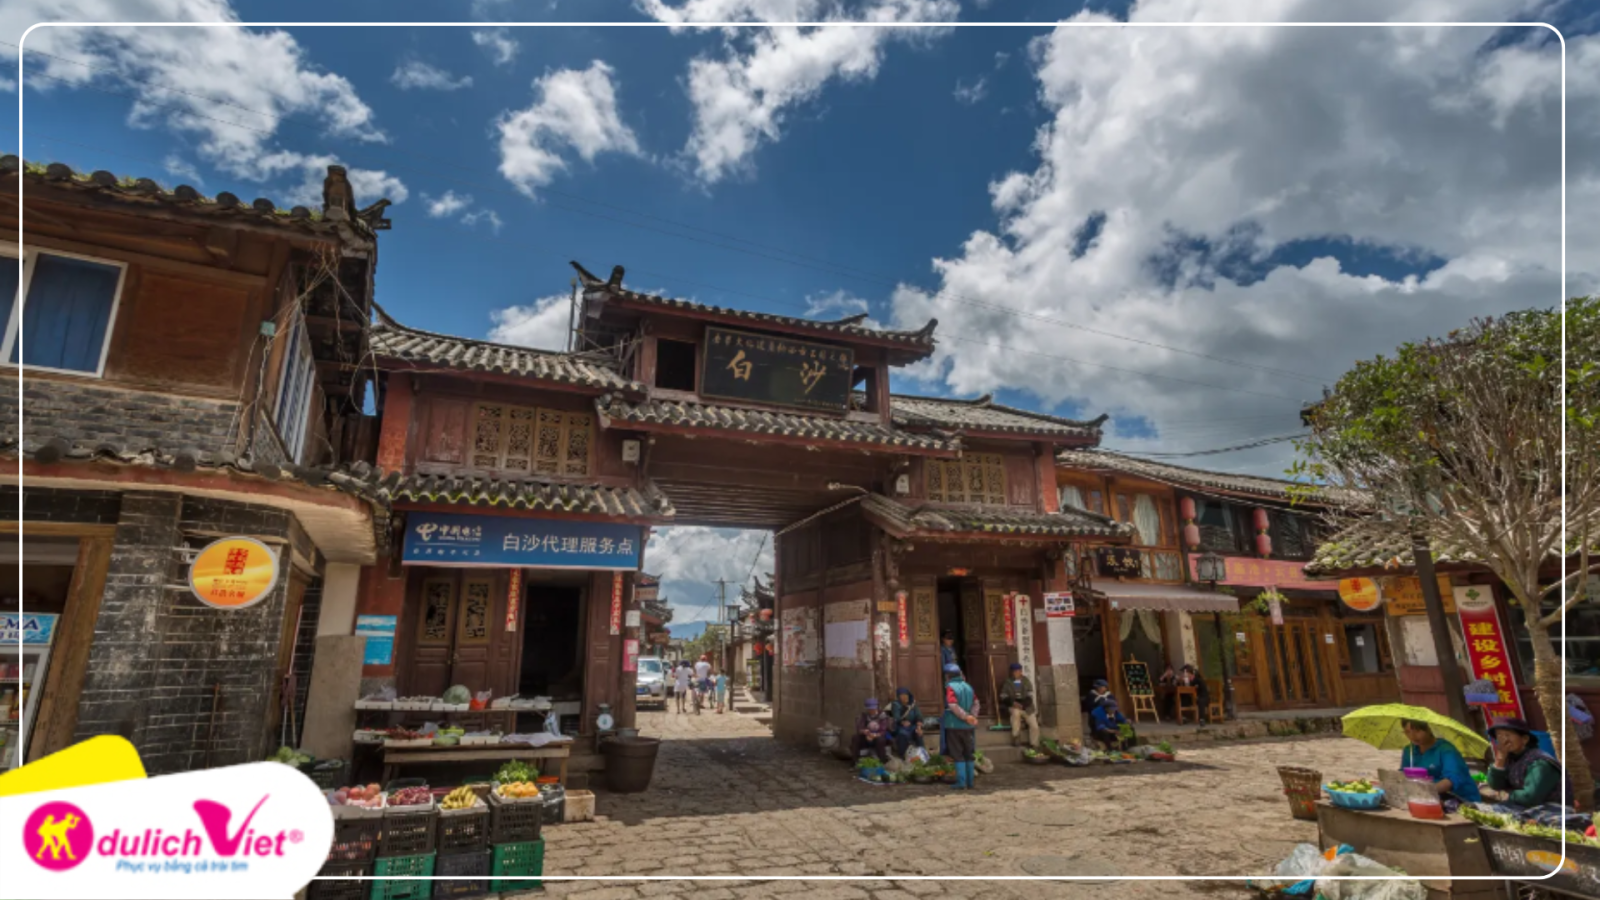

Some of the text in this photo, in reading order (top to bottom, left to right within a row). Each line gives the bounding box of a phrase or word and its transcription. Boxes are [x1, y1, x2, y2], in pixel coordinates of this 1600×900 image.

[726, 350, 827, 394] 白沙
[502, 532, 634, 556] 白沙代理服务点
